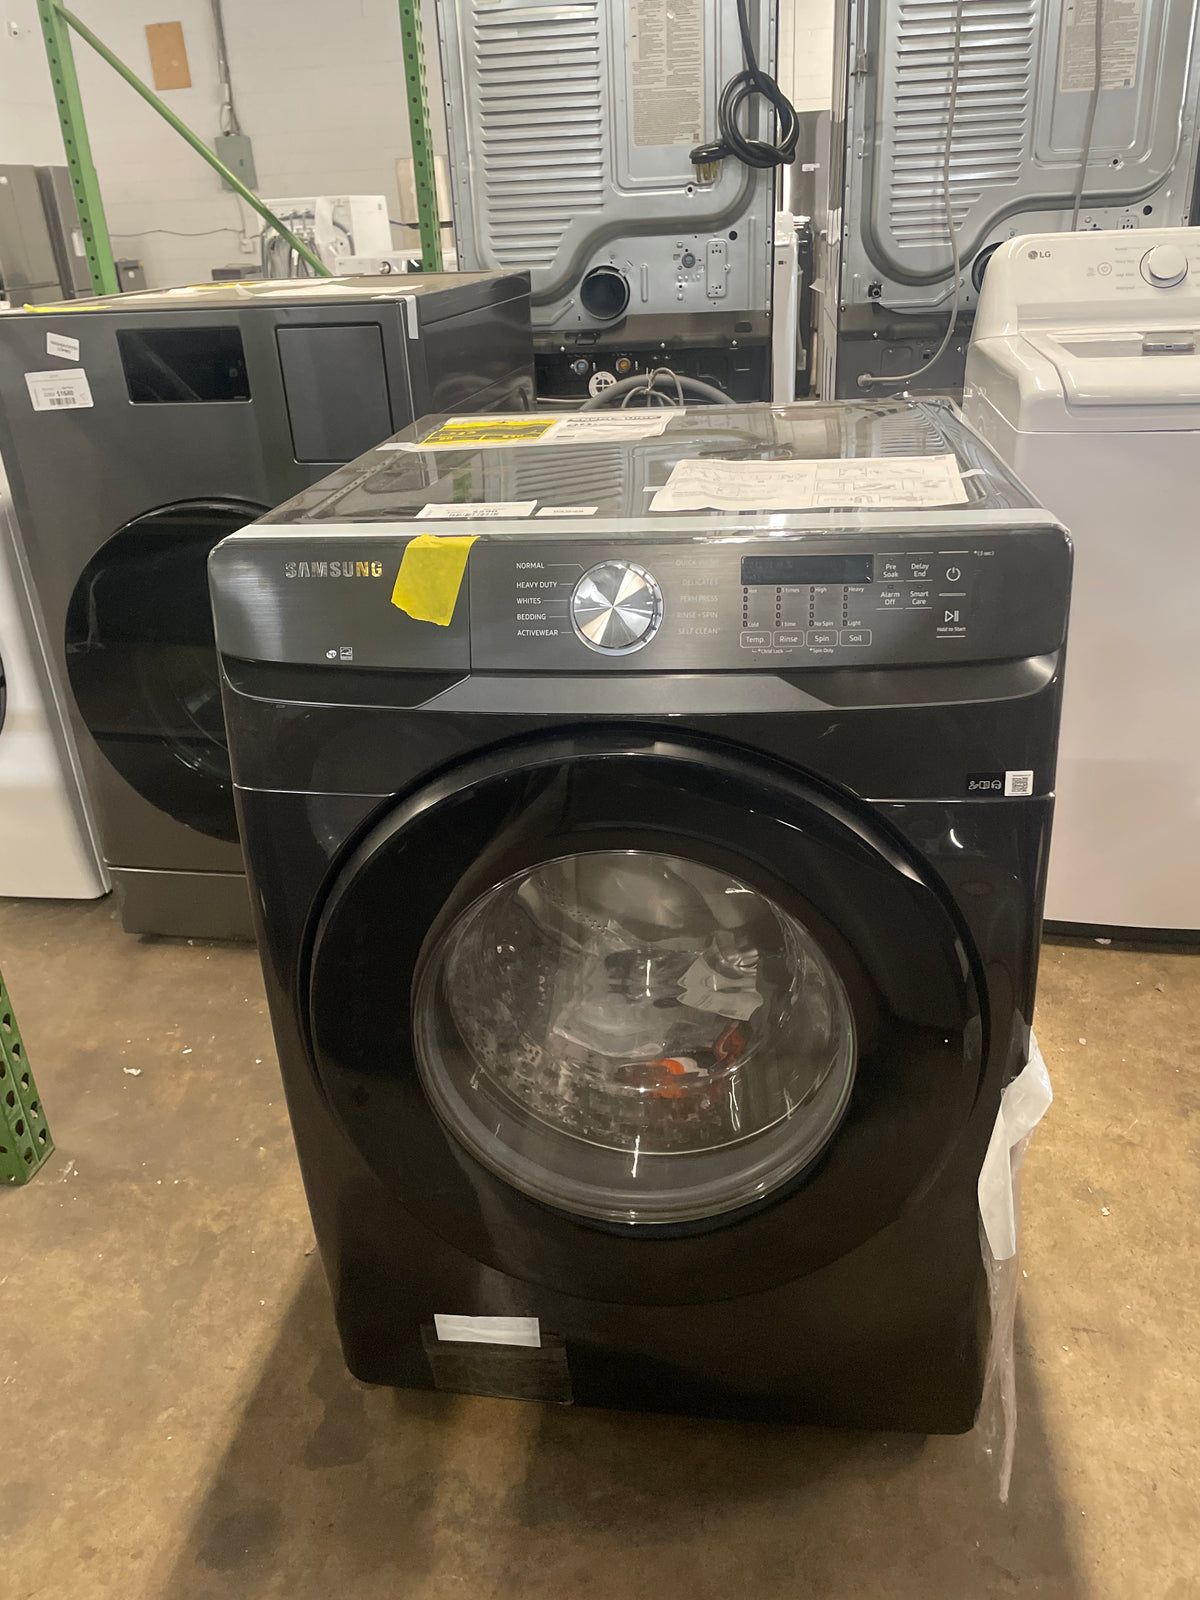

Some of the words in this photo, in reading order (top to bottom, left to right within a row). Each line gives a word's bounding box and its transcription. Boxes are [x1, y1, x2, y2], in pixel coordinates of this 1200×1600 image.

[284, 560, 383, 578] SAMSUNG
[911, 563, 929, 571] Delay
[516, 581, 539, 589] HEAVY
[516, 613, 547, 621] BEDDING
[702, 611, 719, 619] SPIN
[516, 629, 559, 637] ACTIVEWEAR
[678, 627, 694, 635] SELF
[780, 635, 798, 643] Rinse
[815, 635, 830, 643] Spin
[848, 634, 862, 642] Soil
